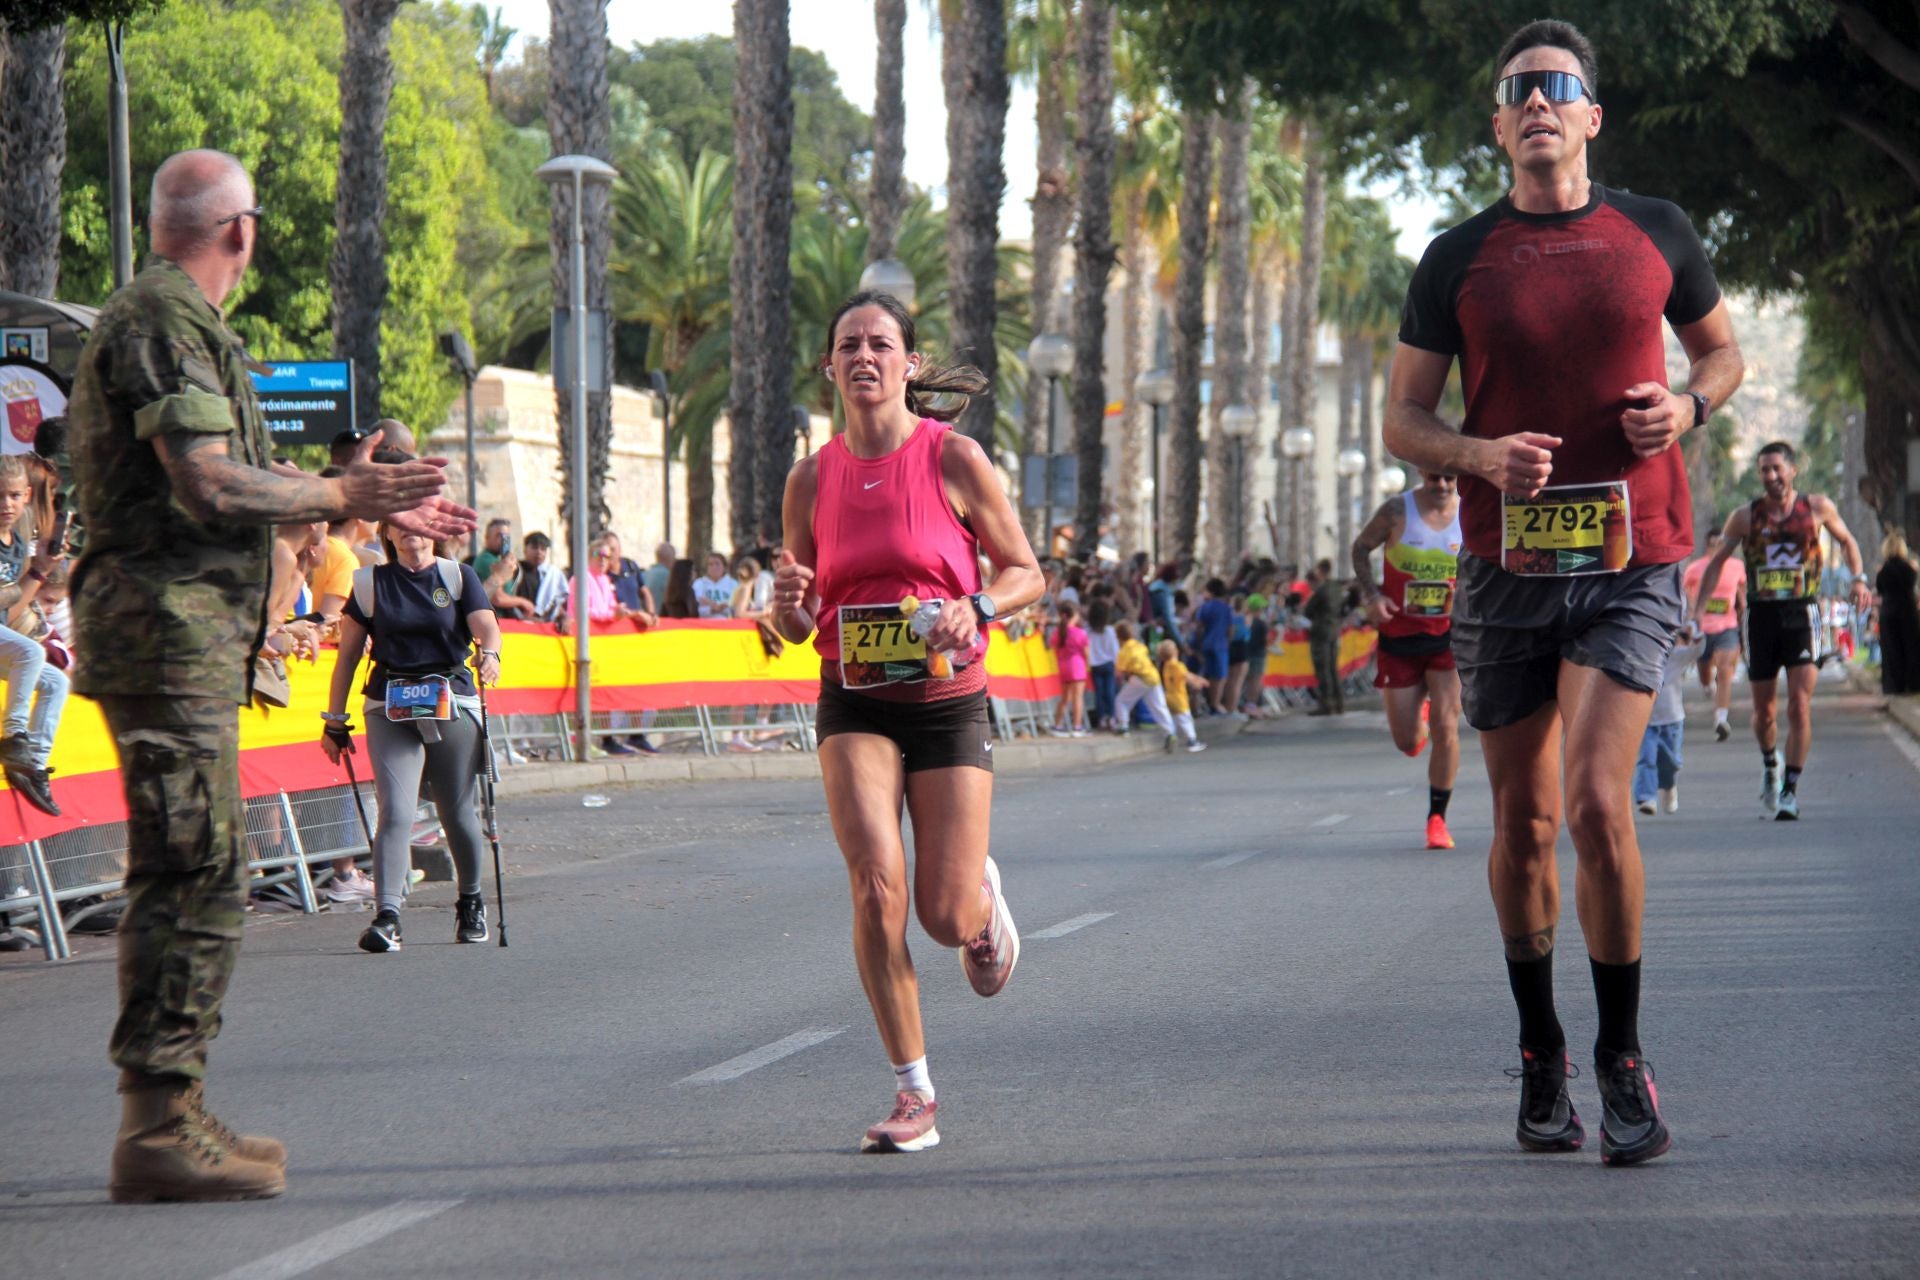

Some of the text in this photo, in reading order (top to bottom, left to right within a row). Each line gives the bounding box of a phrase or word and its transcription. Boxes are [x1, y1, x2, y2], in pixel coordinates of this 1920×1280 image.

[309, 377, 344, 389] Tiempo
[1523, 504, 1598, 533] 2792
[401, 684, 430, 699] 500
